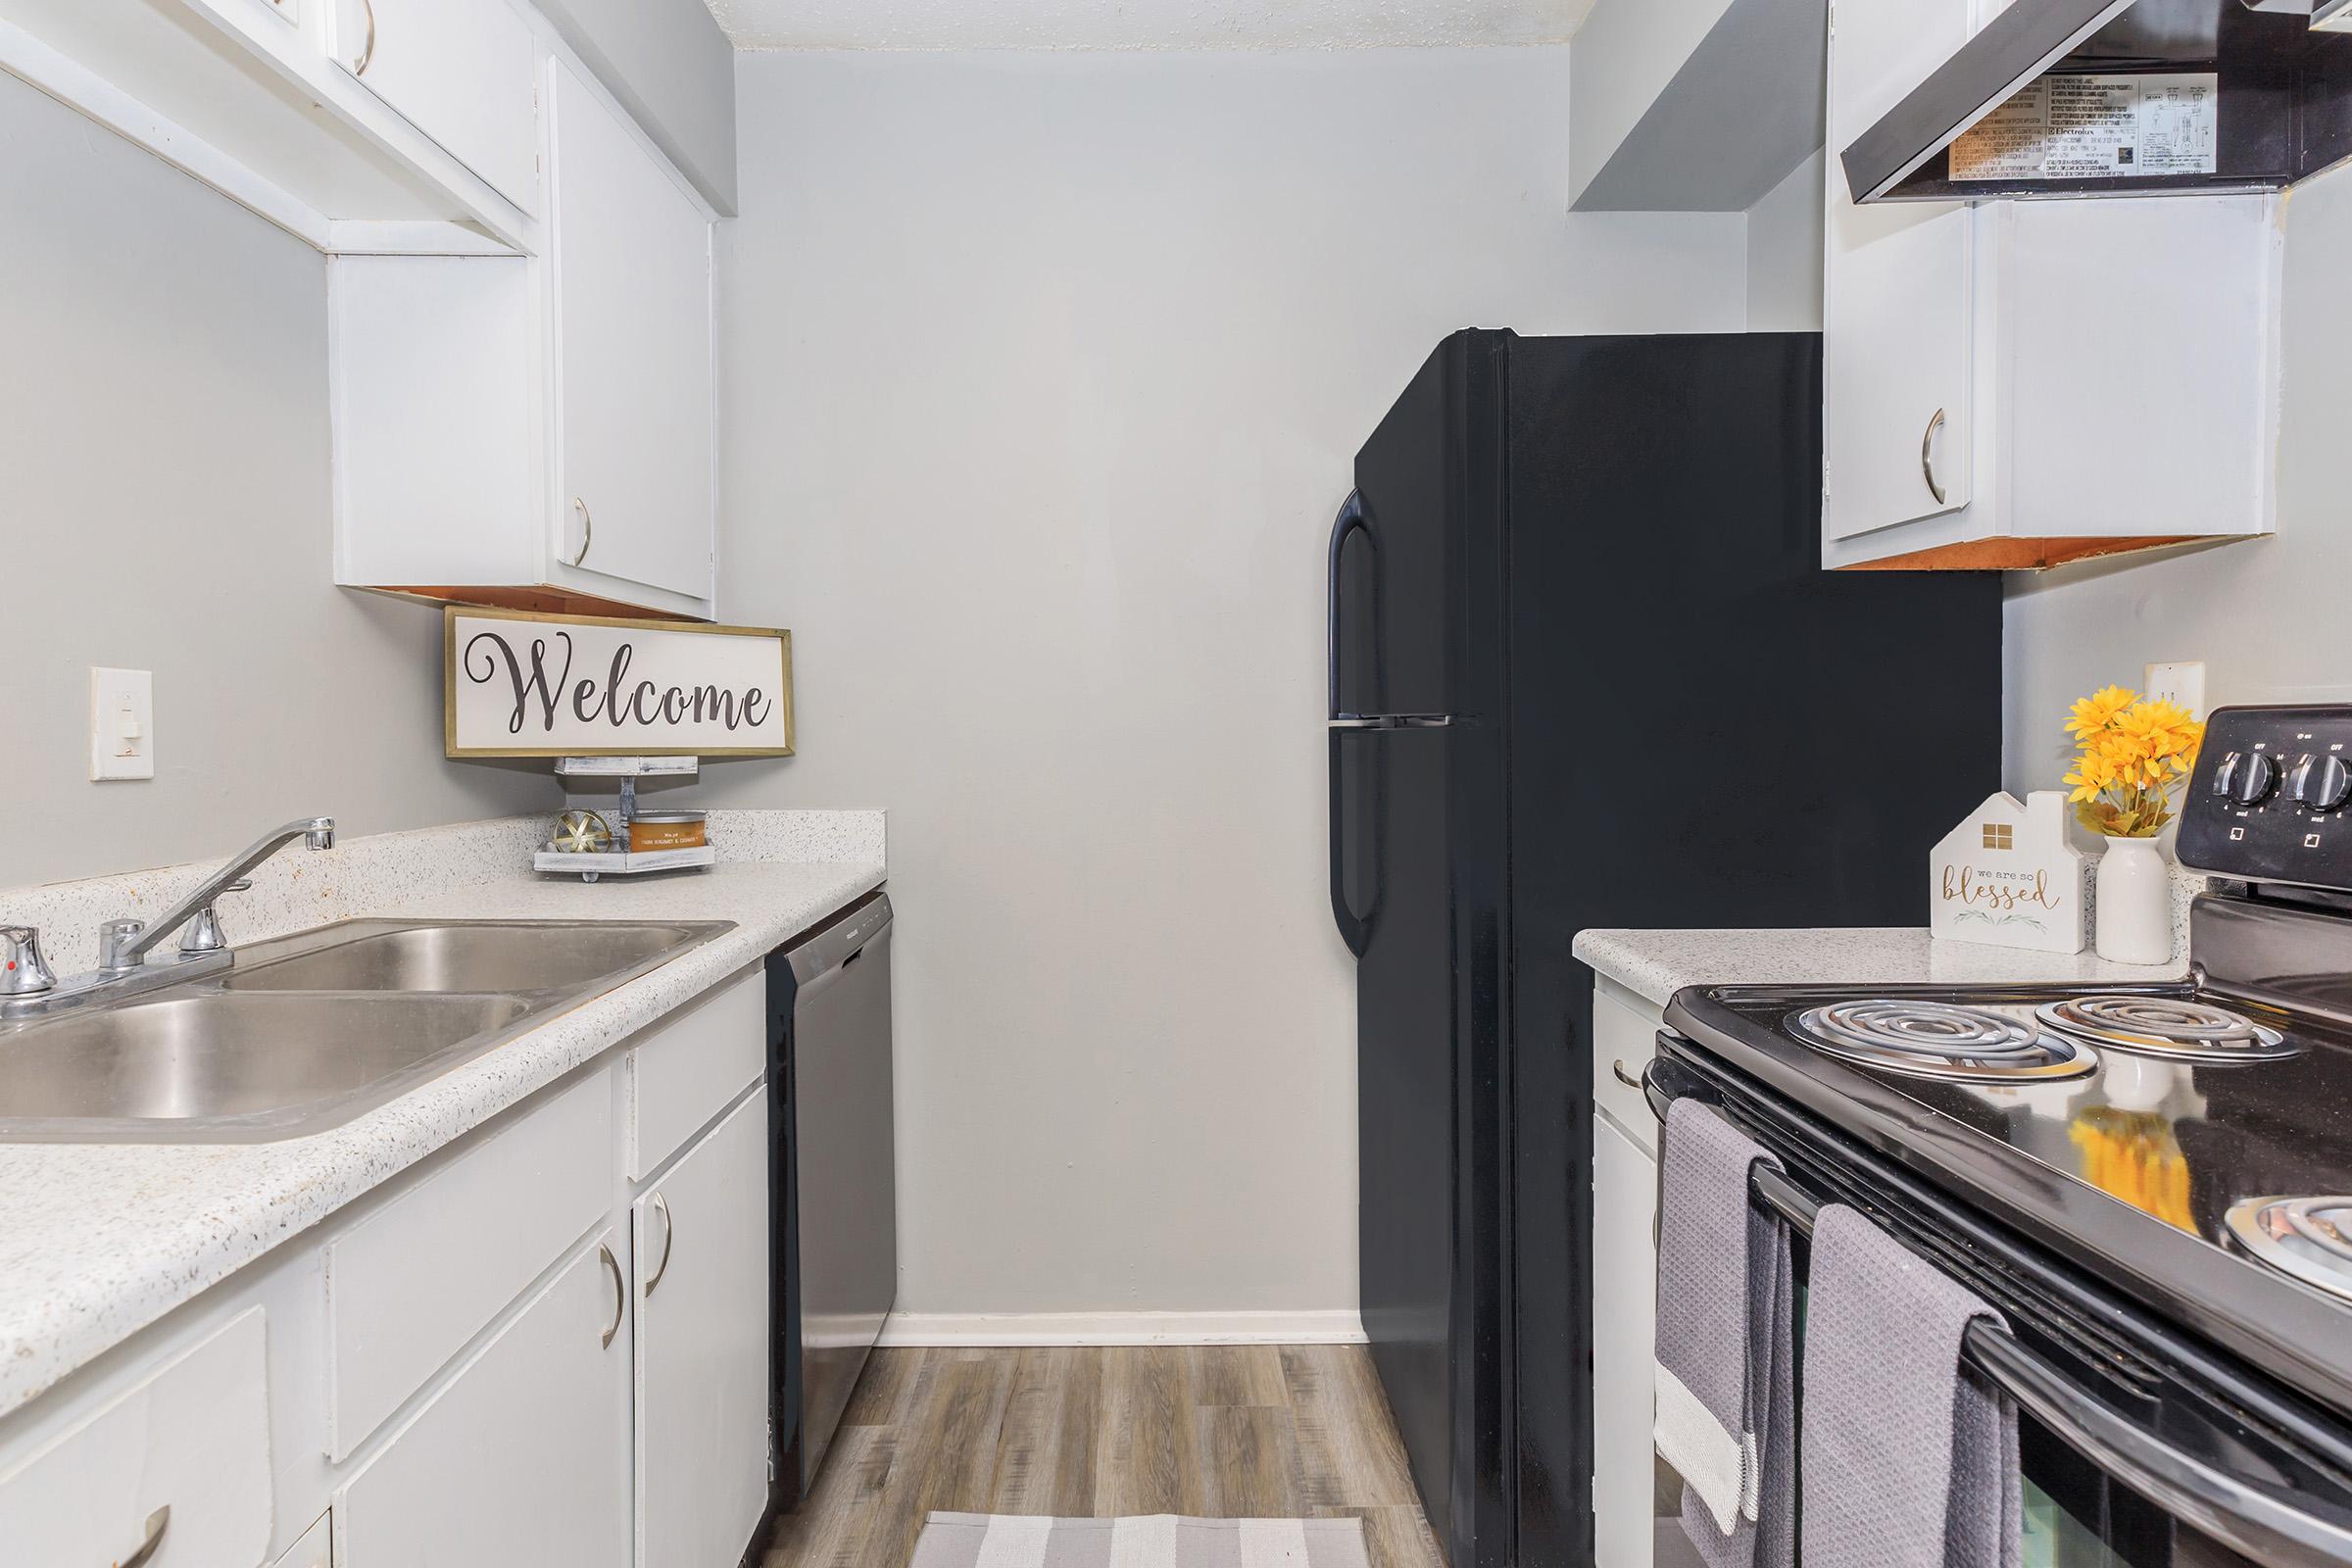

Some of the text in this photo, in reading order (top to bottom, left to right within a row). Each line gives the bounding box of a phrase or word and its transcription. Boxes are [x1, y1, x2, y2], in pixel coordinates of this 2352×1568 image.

[2056, 127, 2094, 136] Electrolux
[464, 631, 772, 734] Welcome
[1943, 864, 2060, 910] blessed
[1996, 871, 2017, 880] are
[2020, 872, 2034, 881] so
